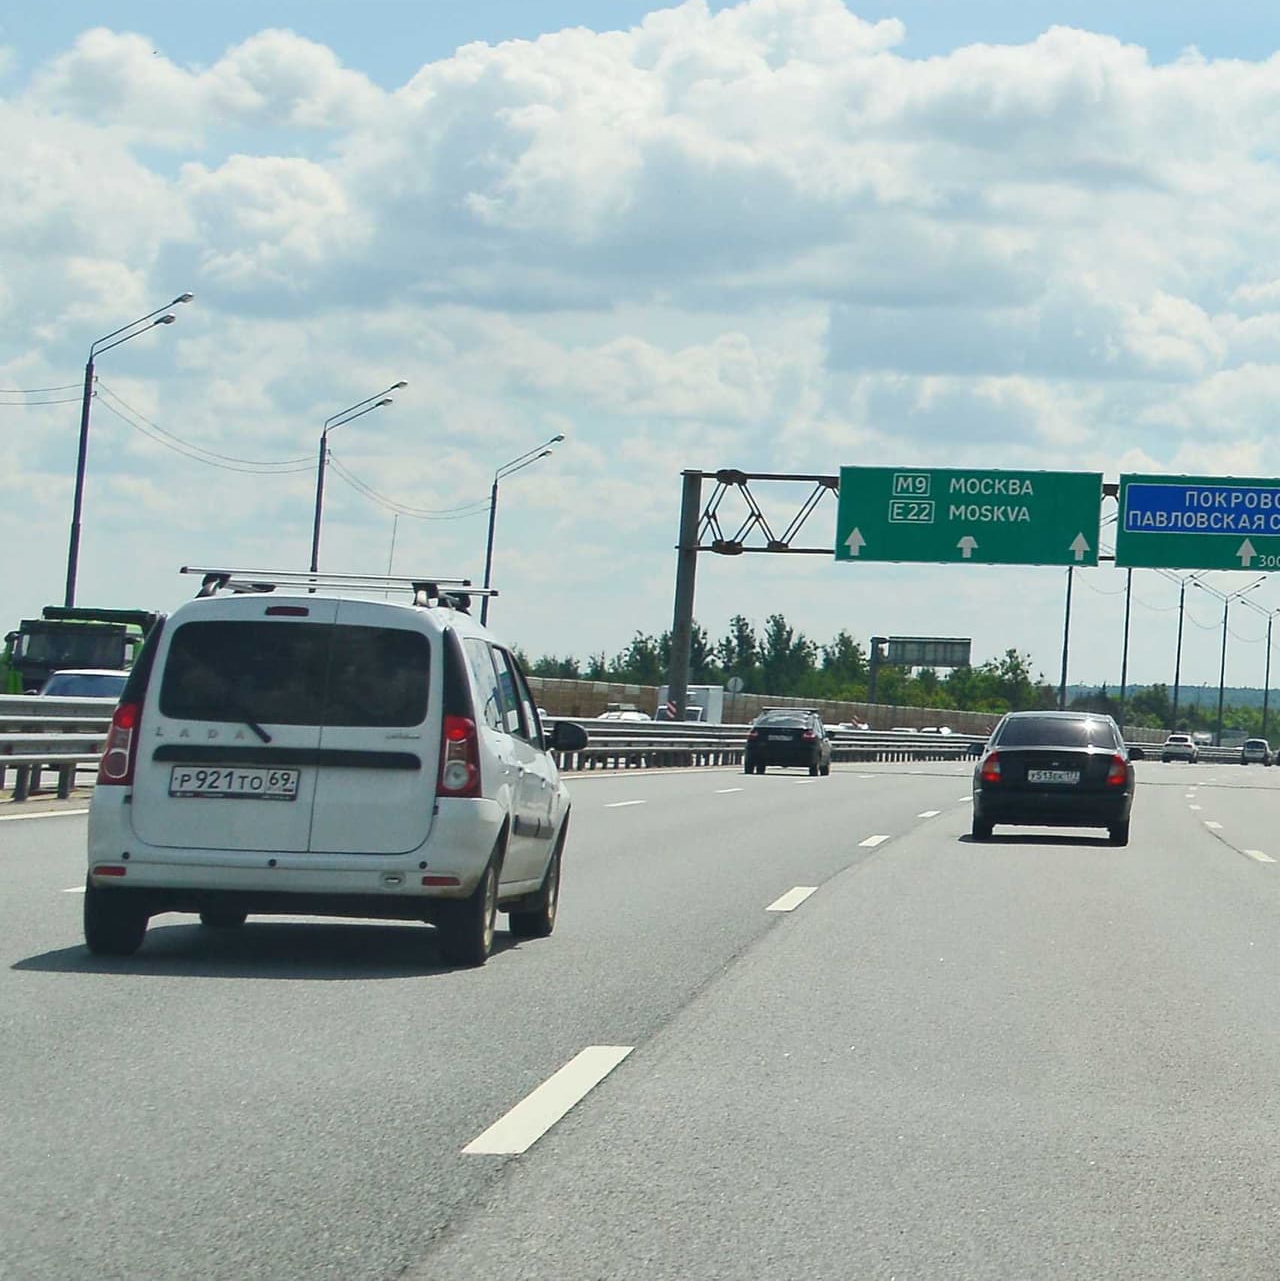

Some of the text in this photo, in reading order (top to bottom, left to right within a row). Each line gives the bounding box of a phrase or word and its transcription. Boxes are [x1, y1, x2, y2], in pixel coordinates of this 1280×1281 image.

[949, 477, 1034, 496] МОСКВА
[948, 504, 1031, 523] MOSKVA
[1129, 510, 1266, 530] ПАВЛОВСКАЯ
[155, 727, 245, 739] LADA
